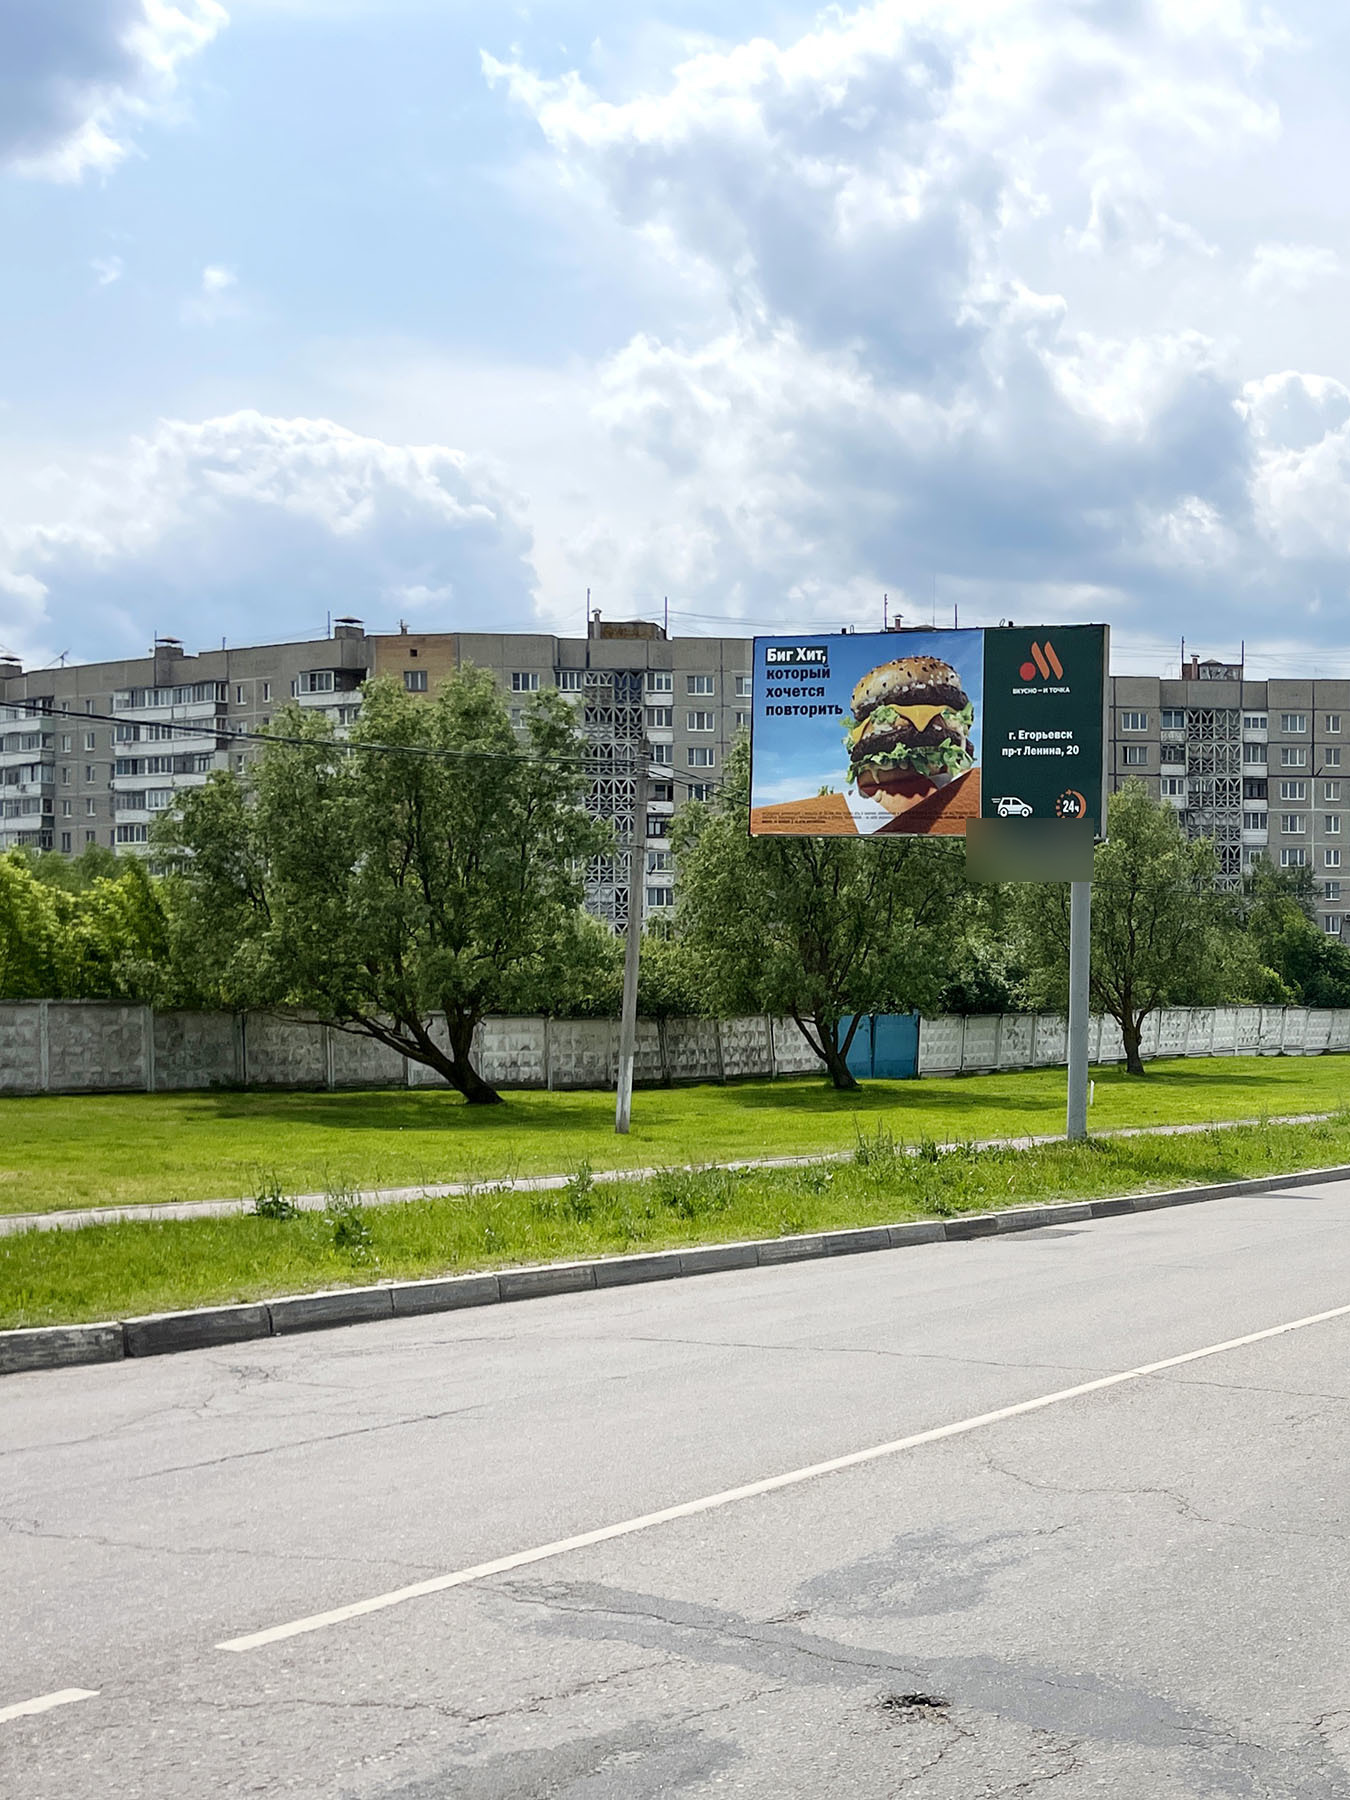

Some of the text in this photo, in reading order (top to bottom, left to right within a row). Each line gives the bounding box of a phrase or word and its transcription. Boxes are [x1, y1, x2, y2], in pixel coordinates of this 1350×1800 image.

[767, 647, 827, 664] Биг Хит,
[766, 664, 831, 682] который
[765, 686, 825, 698] хочется
[1012, 687, 1037, 695] ВКУСНО
[1049, 686, 1071, 694] ТОЧКА
[765, 704, 843, 718] повторить
[1008, 730, 1073, 742] г. Егорьевск
[1001, 745, 1080, 757] пр-т Ленина, 20
